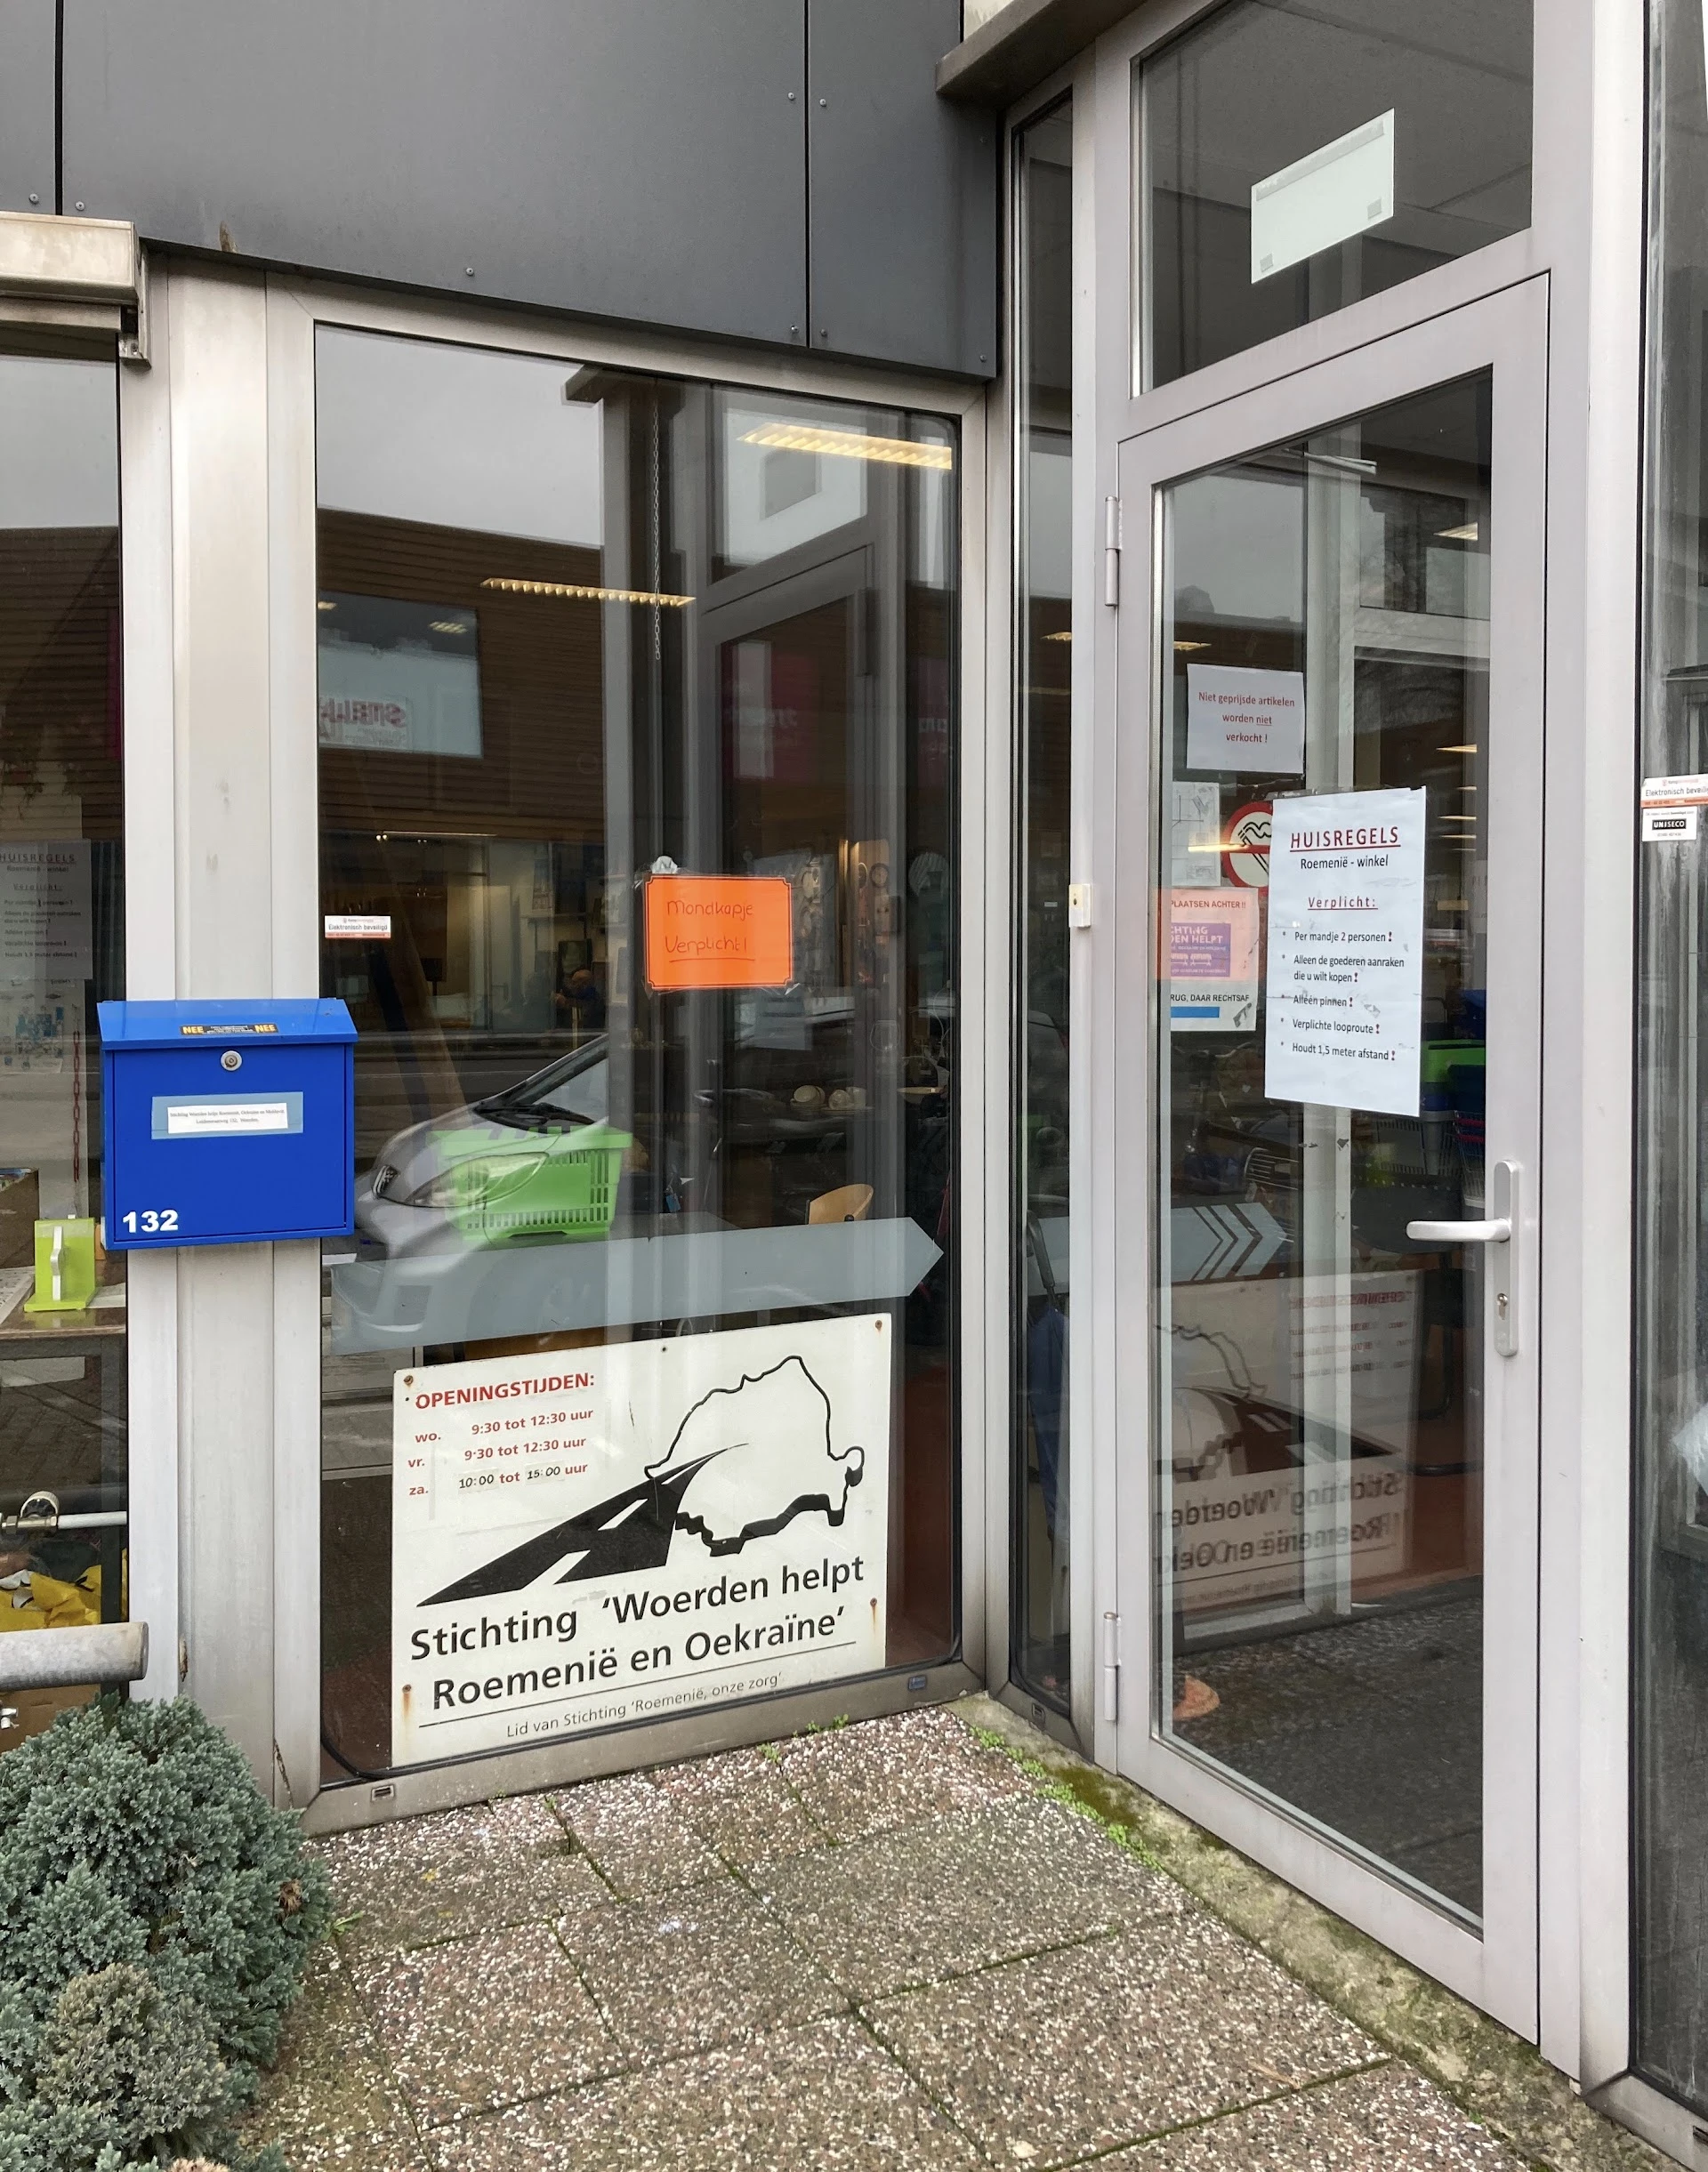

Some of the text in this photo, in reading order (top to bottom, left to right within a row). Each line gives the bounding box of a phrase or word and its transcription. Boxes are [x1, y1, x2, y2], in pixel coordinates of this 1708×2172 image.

[1198, 691, 1295, 707] Niet geprijsde artikelen
[1222, 712, 1272, 725] worden niet
[1226, 732, 1262, 743] verkocht
[1645, 788, 1685, 797] Elektronisch
[1653, 820, 1686, 828] UNISECO
[1290, 826, 1399, 849] HUISREGELS
[1301, 857, 1349, 869] Roemenië
[1357, 854, 1389, 867] winkel
[1211, 900, 1240, 908] ACHTER
[1308, 896, 1375, 909] Verplicht:
[667, 900, 753, 921] Mondkapje
[1191, 935, 1223, 945] HELPT
[1294, 931, 1308, 941] Per
[1309, 931, 1339, 944] mandje
[1341, 932, 1346, 942] 2
[1348, 932, 1386, 944] personen
[1293, 954, 1405, 968] Alleen de goederen aanraken
[1293, 970, 1306, 980] die
[1313, 971, 1327, 981] wilt
[1328, 971, 1352, 984] kopen
[1213, 994, 1250, 1002] RECHTSAF
[1319, 996, 1347, 1007] pinnen
[182, 1026, 205, 1034] NEE
[254, 1024, 277, 1034] NEE
[1293, 1018, 1332, 1030] Verplichte
[1333, 1021, 1374, 1034] looproute
[1292, 1042, 1317, 1054] Houdt
[1318, 1045, 1330, 1057] 1,5
[1332, 1048, 1357, 1058] meter
[1358, 1049, 1389, 1060] afstand
[122, 1209, 179, 1234] 132
[415, 1372, 595, 1410] OPENINGSTIJDEN:
[415, 1409, 594, 1444] wo. 9:30 tot 12:30 uur
[407, 1458, 425, 1468] vr.
[497, 1444, 519, 1456] tot
[523, 1439, 560, 1453] 12:30
[563, 1436, 587, 1449] uur
[408, 1463, 588, 1496] za. 10:00 tot 15:00 uur
[410, 1611, 578, 1661] Stichting
[781, 1556, 865, 1596] helpt
[433, 1647, 618, 1710] Roemenië
[630, 1644, 672, 1671] en
[506, 1719, 529, 1739] Lid
[533, 1717, 560, 1732] van
[563, 1702, 627, 1727] Stichting
[712, 1681, 745, 1696] onze
